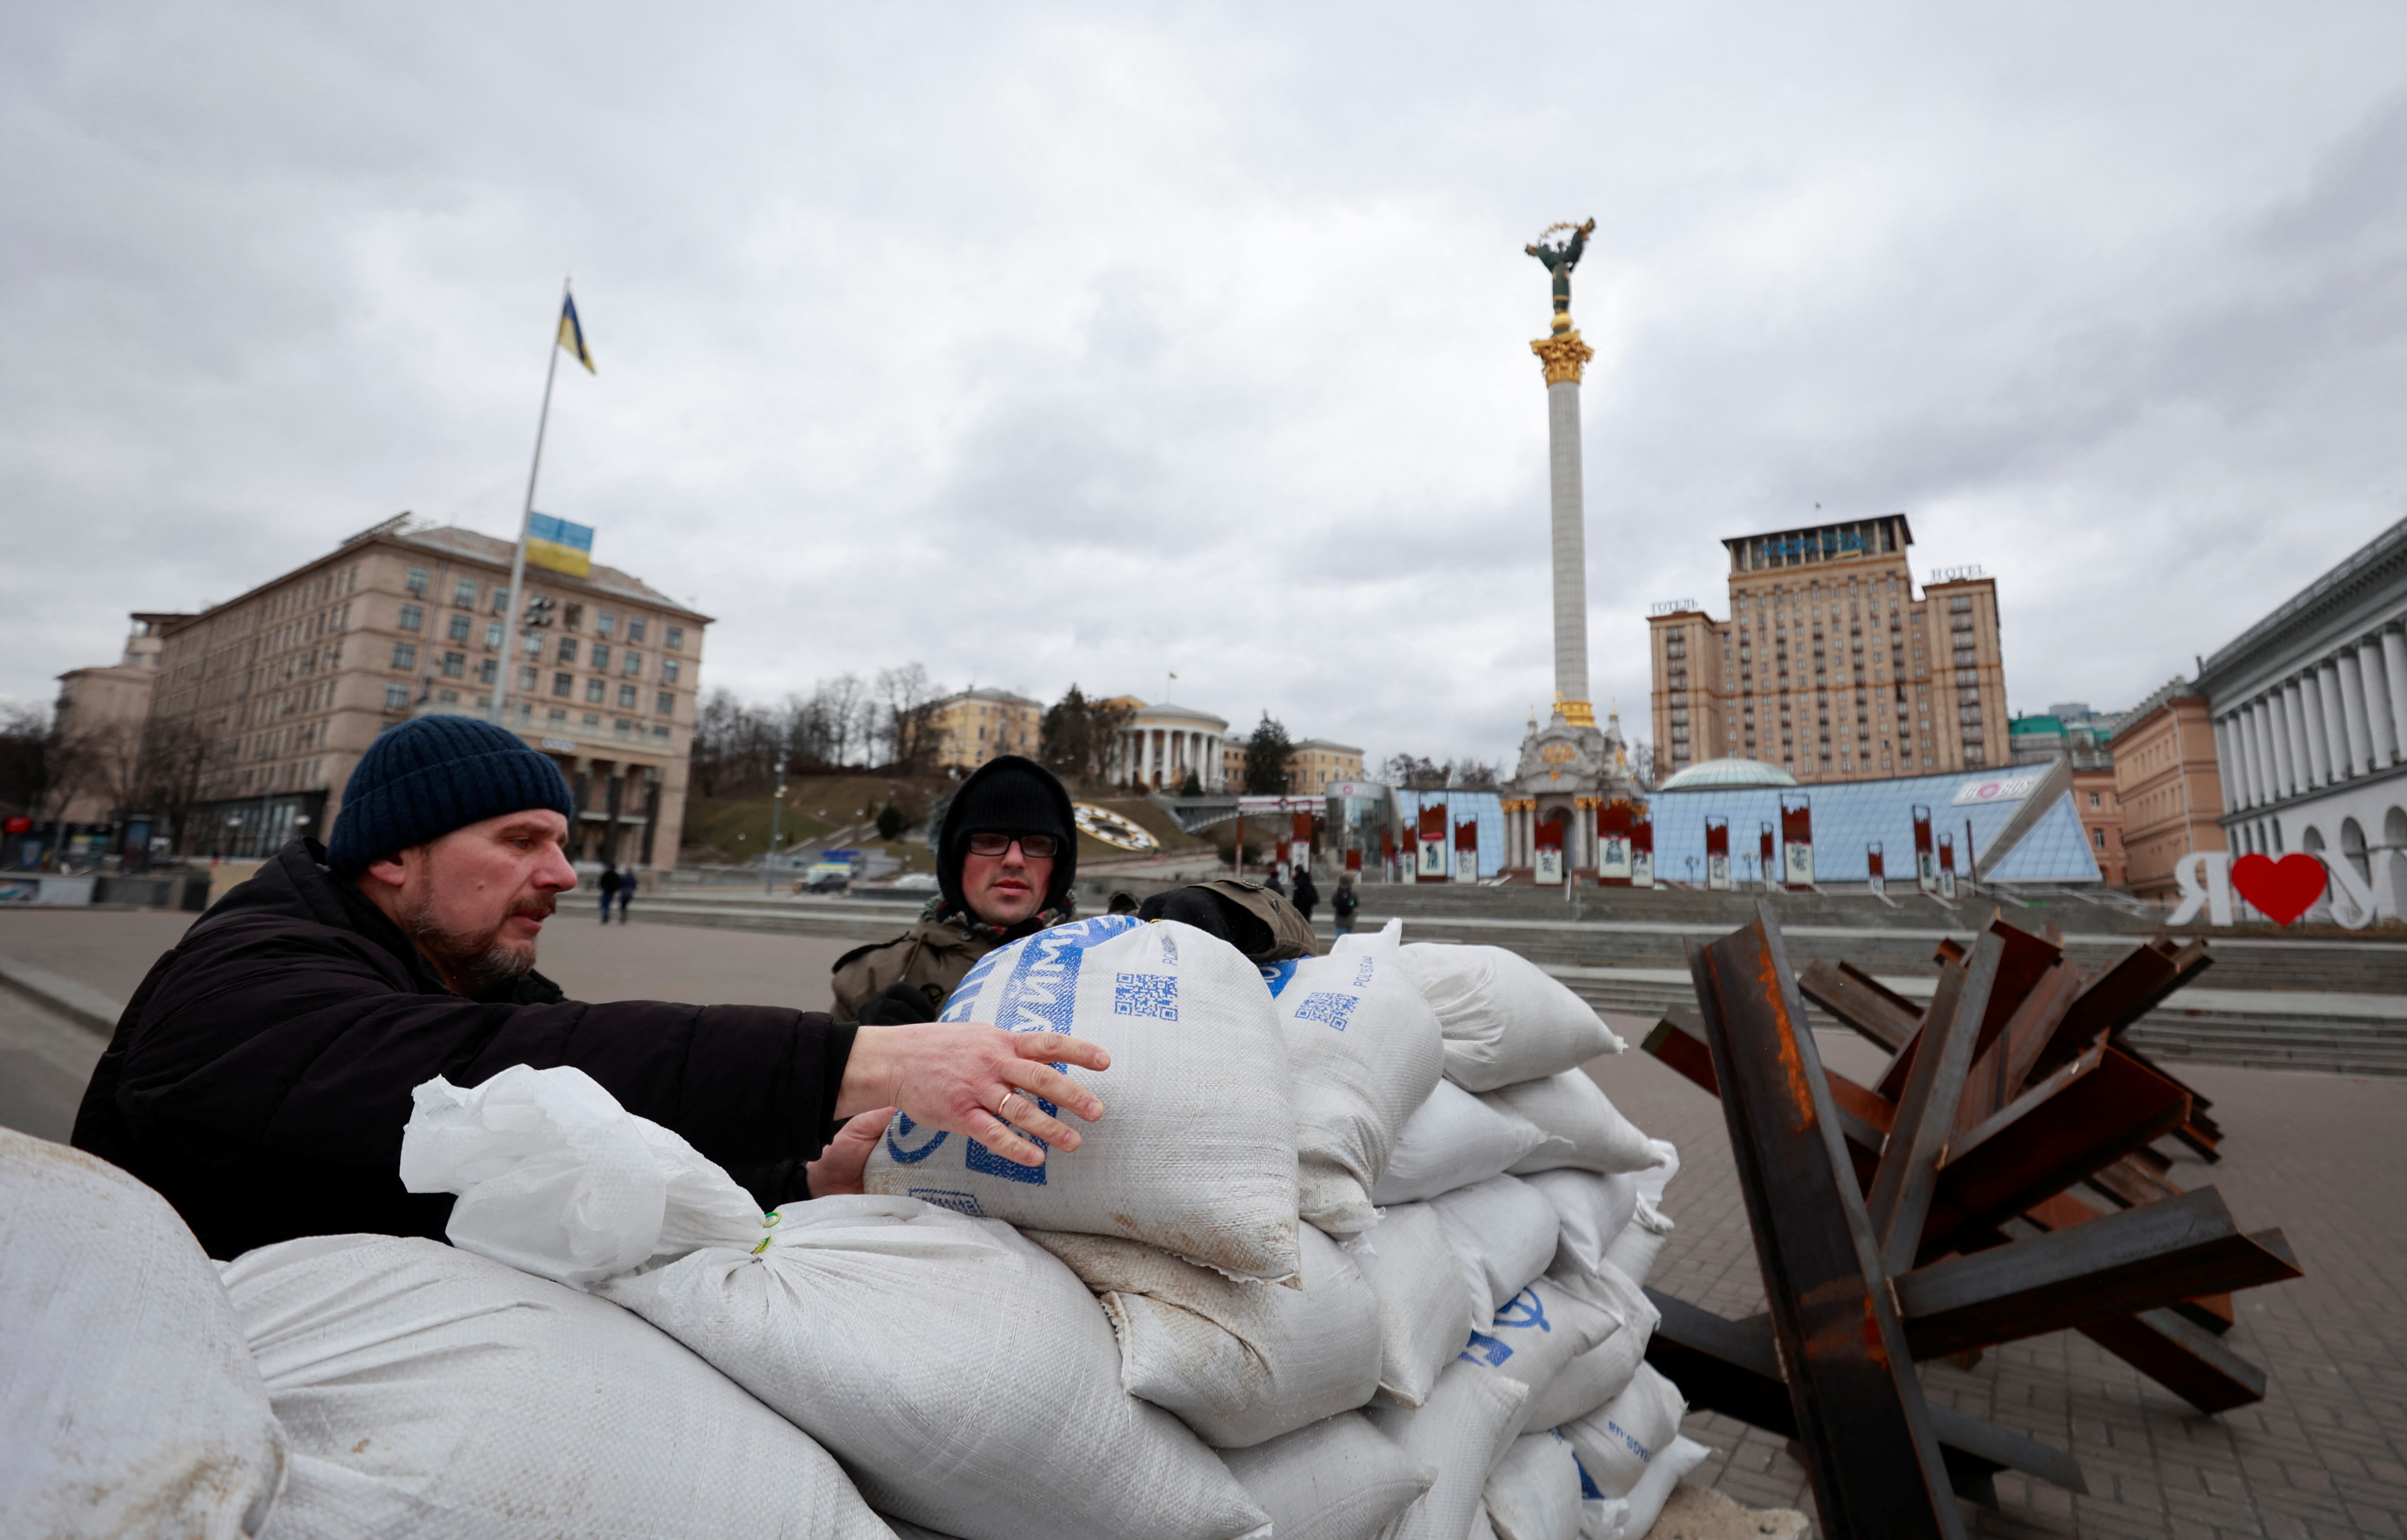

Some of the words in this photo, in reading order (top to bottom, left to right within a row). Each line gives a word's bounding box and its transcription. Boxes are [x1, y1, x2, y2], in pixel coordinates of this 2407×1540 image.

[1762, 531, 1866, 558] УКРАЇНА
[1932, 564, 1988, 580] HOTEL
[1652, 599, 1699, 612] ГОТЕЛЬ
[1962, 777, 2035, 800] GLOBUS
[2165, 851, 2234, 927] Я
